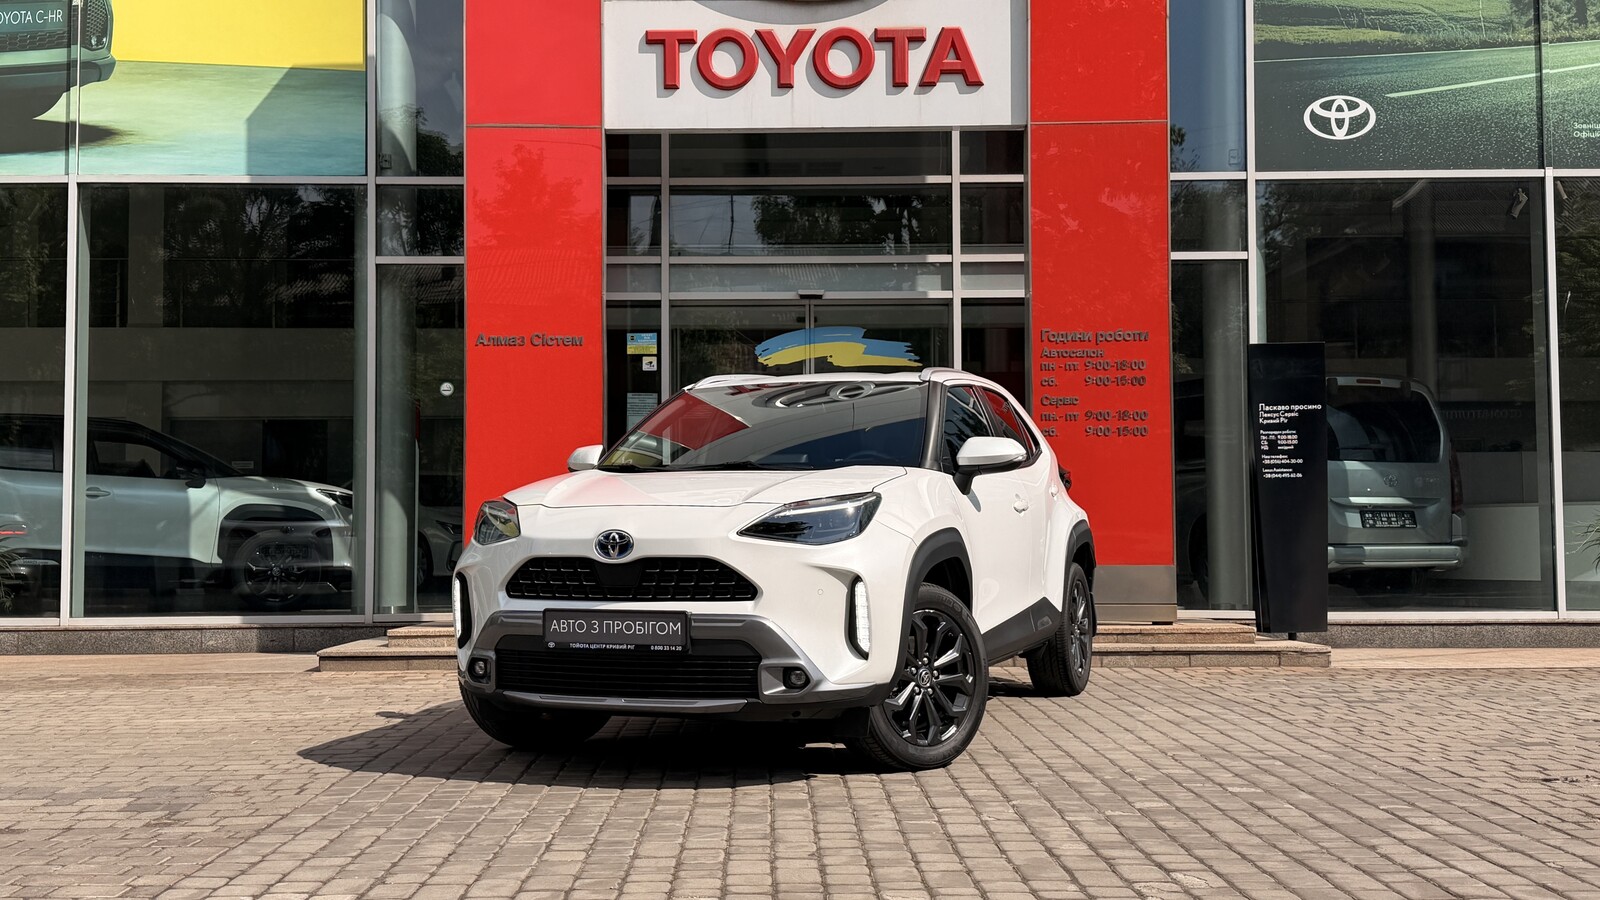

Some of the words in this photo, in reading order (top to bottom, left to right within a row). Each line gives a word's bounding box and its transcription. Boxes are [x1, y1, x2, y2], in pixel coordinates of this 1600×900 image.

[36, 10, 63, 23] C-HR
[645, 26, 984, 90] TOYOTA
[475, 333, 526, 346] Алмаз
[530, 333, 584, 346] Сістем
[1041, 329, 1092, 344] Години
[1096, 329, 1149, 344] роботи
[1041, 348, 1104, 358] Автосалон
[1084, 360, 1146, 371] 9:00-18:00
[1041, 376, 1058, 387] сб.
[1084, 376, 1146, 386] 9:00-15:00
[1041, 394, 1079, 407] Сервіс
[1259, 404, 1290, 412] Ласкаво
[1085, 410, 1149, 421] 9:00-18:00
[1085, 426, 1149, 437] 9:00-15:00
[550, 620, 586, 633] АВТО
[590, 620, 599, 633] З
[603, 620, 681, 634] ПРОБІГОМ
